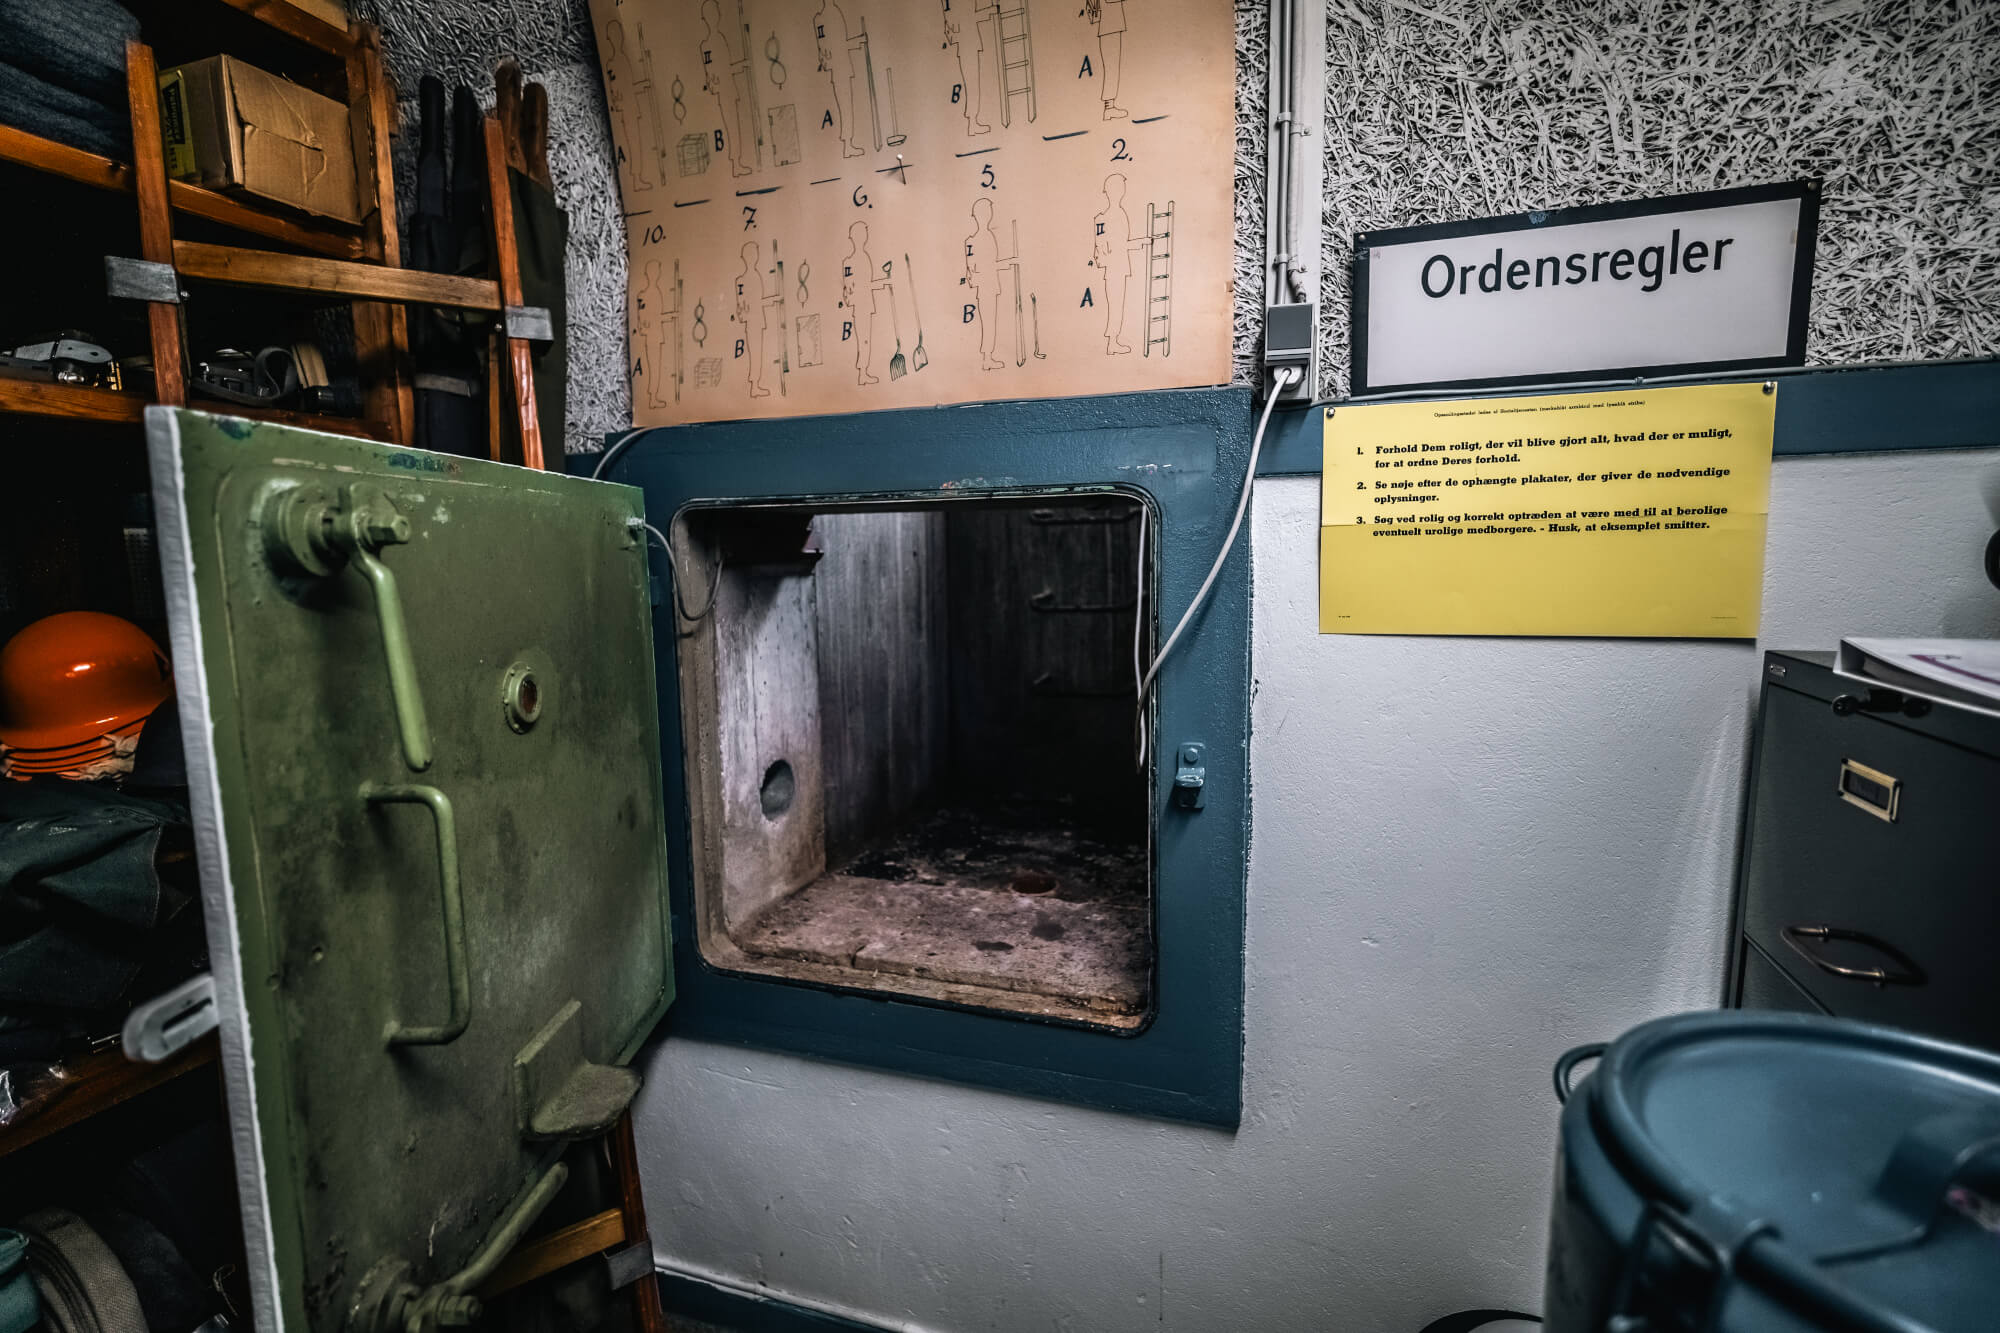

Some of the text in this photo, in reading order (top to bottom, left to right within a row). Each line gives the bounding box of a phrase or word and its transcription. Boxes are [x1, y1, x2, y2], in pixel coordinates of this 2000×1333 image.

[817, 25, 826, 39] II
[703, 51, 712, 64] II
[1079, 55, 1093, 79] A
[951, 83, 962, 103] B
[821, 110, 833, 129] A
[714, 129, 724, 152] B
[1110, 139, 1132, 162] 2.
[616, 146, 626, 166] A
[981, 164, 996, 190] 5.
[853, 184, 873, 209] 6.
[743, 206, 757, 231] 7.
[643, 225, 666, 246] 10.
[1096, 223, 1105, 236] II
[965, 243, 973, 257] I
[844, 267, 853, 277] II
[1421, 228, 1734, 298] Ordensregler
[736, 282, 744, 295] I
[1080, 287, 1093, 308] A
[963, 304, 976, 323] B
[842, 321, 853, 341] B
[735, 339, 744, 359] B
[631, 358, 642, 379] A
[1357, 447, 1364, 455] 1.
[1376, 444, 1417, 454] Forhold
[1421, 444, 1445, 452] Dem
[1450, 442, 1482, 451] roligt,
[1486, 440, 1504, 448] der
[1507, 439, 1522, 447] vil
[1527, 438, 1555, 447] blive
[1559, 436, 1587, 447] gjort
[1590, 435, 1610, 444] alt,
[1614, 432, 1644, 442] hvad
[1649, 432, 1669, 440] der
[1688, 429, 1732, 439] muligt,
[1375, 460, 1390, 468] for
[1407, 458, 1438, 467] ordne
[1442, 457, 1472, 465] Deres
[1476, 454, 1520, 464] forhold.
[1357, 467, 1730, 490] 2. Se nøje efter de ophængte plakater, der giver de nødvendige
[1374, 494, 1439, 504] oplysninger.
[1356, 516, 1366, 524] 3.
[1374, 516, 1393, 525] Søg
[1396, 515, 1416, 524] ved
[1419, 514, 1444, 524] rolig
[1464, 513, 1504, 522] korrekt
[1508, 511, 1562, 521] optræden
[1566, 510, 1577, 518] at
[1581, 510, 1610, 518] være
[1614, 508, 1640, 517] med
[1644, 507, 1657, 517] til
[1661, 508, 1672, 516] at
[1677, 505, 1728, 516] berolige
[1373, 527, 1421, 536] eventuelt
[1425, 527, 1463, 536] urolige
[1467, 525, 1536, 535] medborgere.
[1548, 523, 1581, 533] Husk,
[1585, 523, 1596, 531] at
[1600, 521, 1660, 532] eksemplet
[1664, 520, 1710, 529] smitter.
